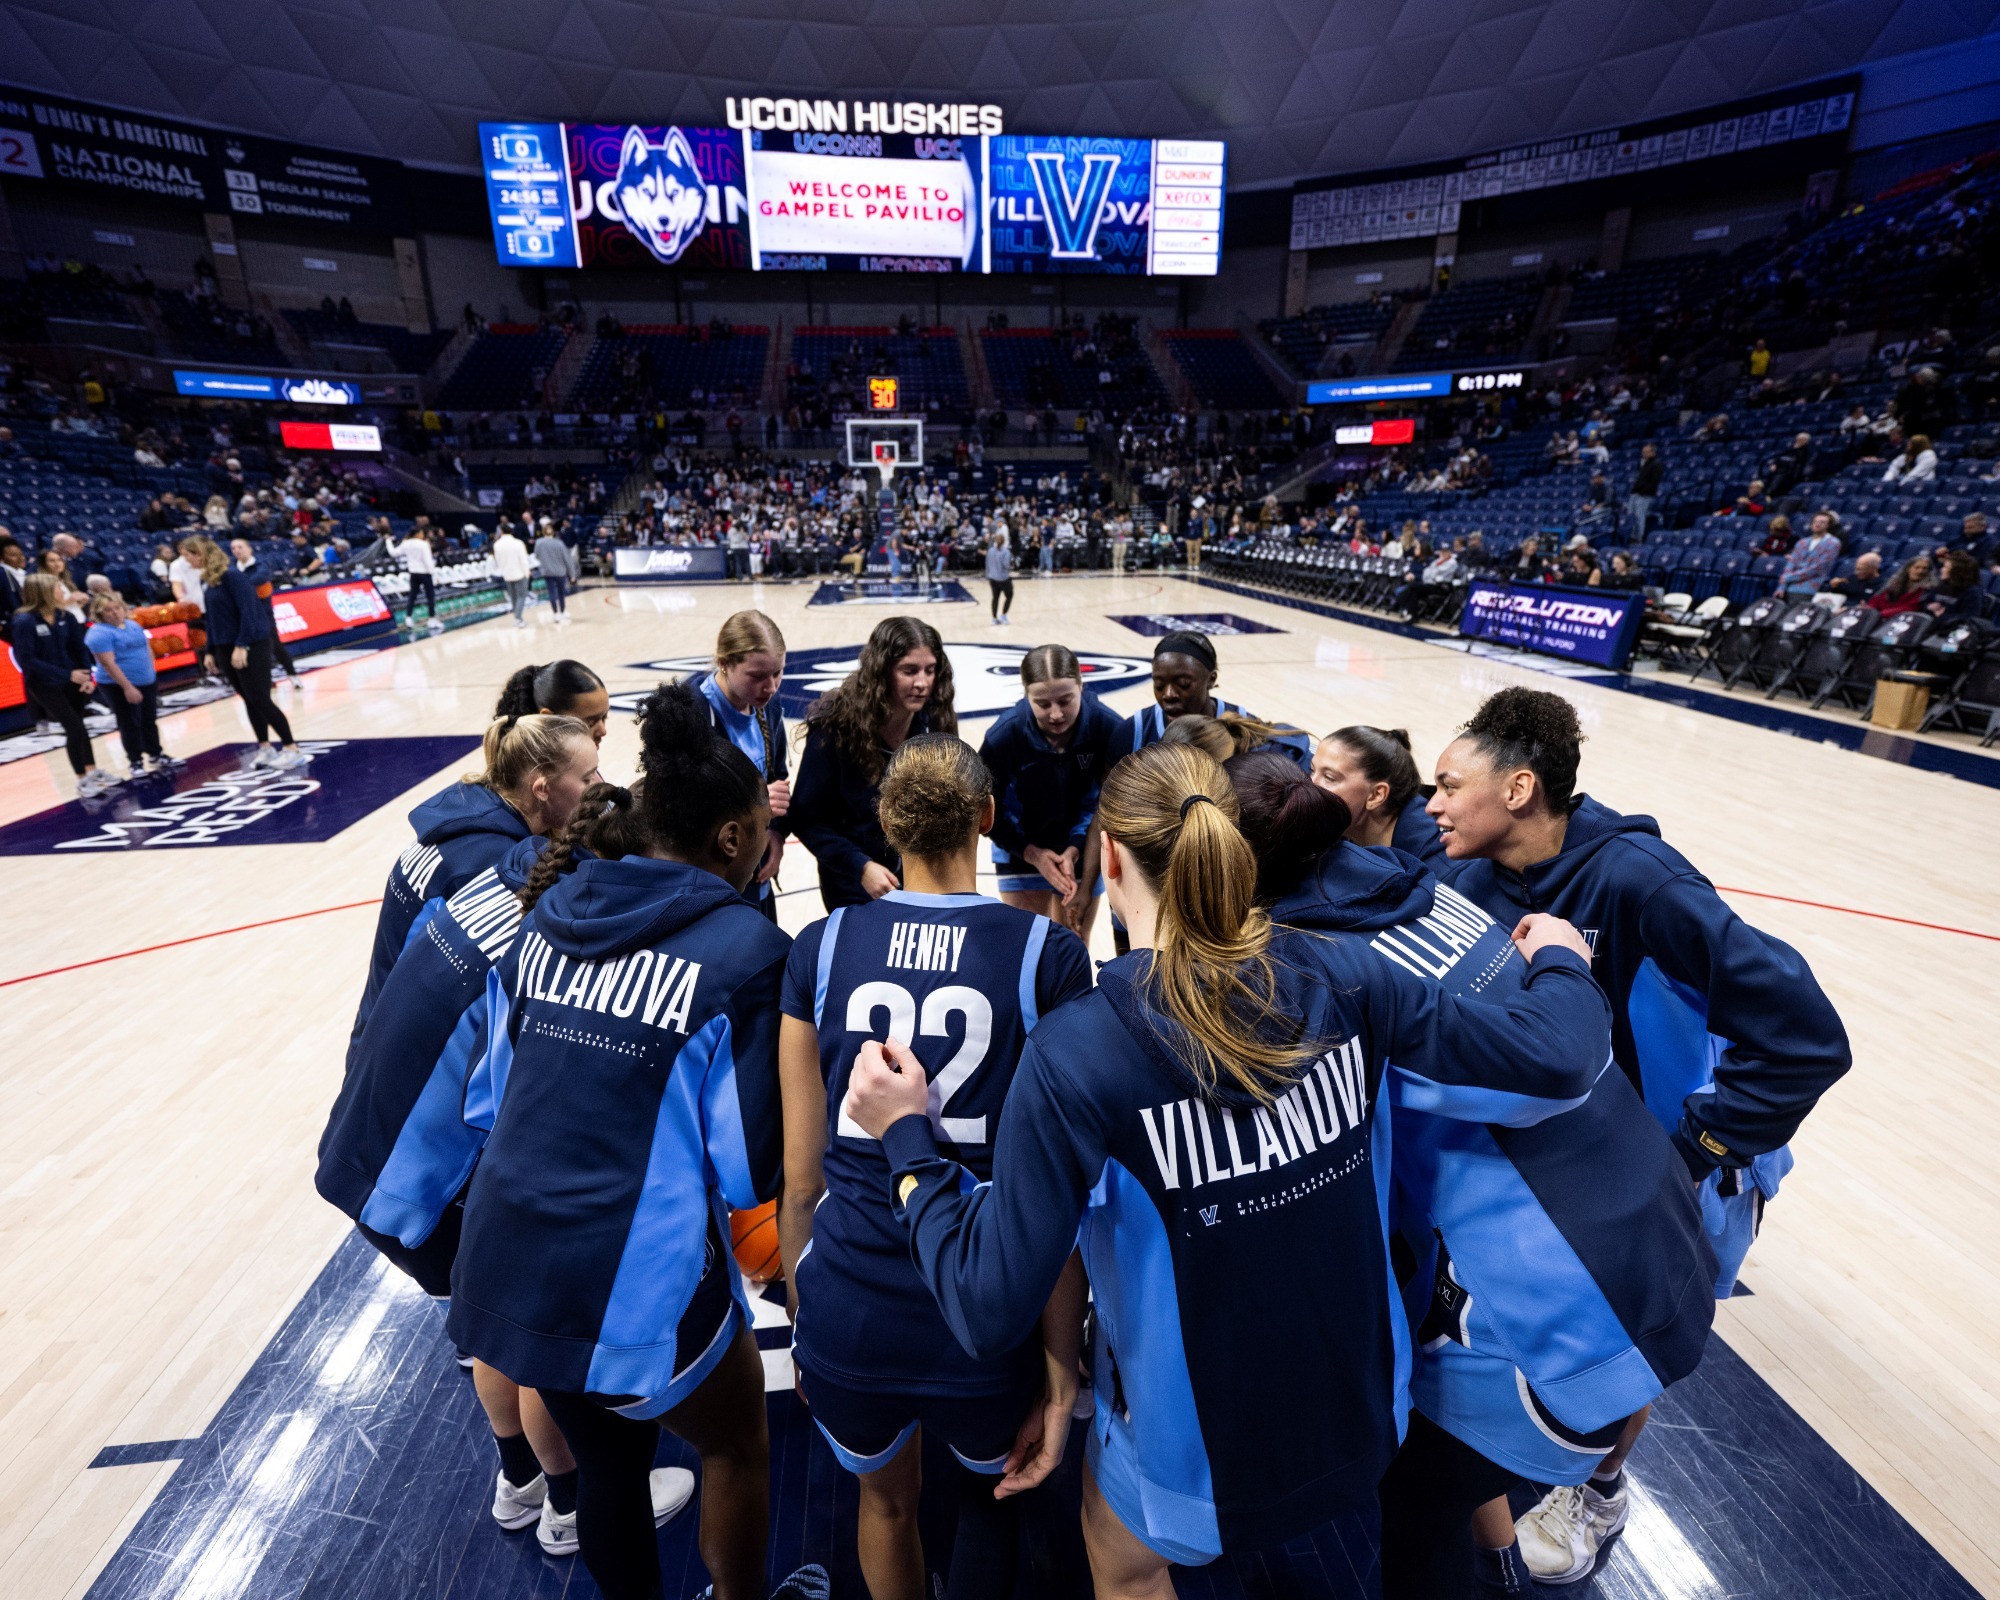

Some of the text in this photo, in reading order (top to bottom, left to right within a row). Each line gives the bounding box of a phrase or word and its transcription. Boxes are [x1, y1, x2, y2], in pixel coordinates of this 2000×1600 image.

[726, 97, 1002, 136] UCONN HUSKIES
[112, 119, 208, 156] BASKETBALL
[515, 140, 529, 157] 0
[793, 132, 883, 157] UCONN
[51, 142, 201, 186] NATIONAL
[1164, 169, 1218, 181] DUNKIN'
[56, 164, 206, 200] CHAMPIONSHIPS
[259, 178, 320, 197] REGULAR
[321, 188, 372, 206] SEASON
[789, 181, 948, 201] WELCOME TO
[1026, 152, 1121, 258] V
[1163, 191, 1217, 204] xerox
[264, 200, 351, 222] TOURNAMENT
[760, 201, 963, 222] GAMPEL PAVILIO
[528, 235, 541, 252] 0
[1458, 372, 1522, 390] 6:19 PM
[873, 389, 895, 408] 30
[1545, 620, 1606, 639] TRAINING
[142, 779, 321, 846] REED
[887, 922, 967, 972] HENRY
[515, 932, 702, 1035] VILLANOVA
[537, 1021, 610, 1043] ENGINEERED
[621, 1040, 646, 1052] FOR
[838, 981, 992, 1144] 22
[1237, 1148, 1365, 1209] ENGINEERED FOR
[1441, 1285, 1451, 1302] XL
